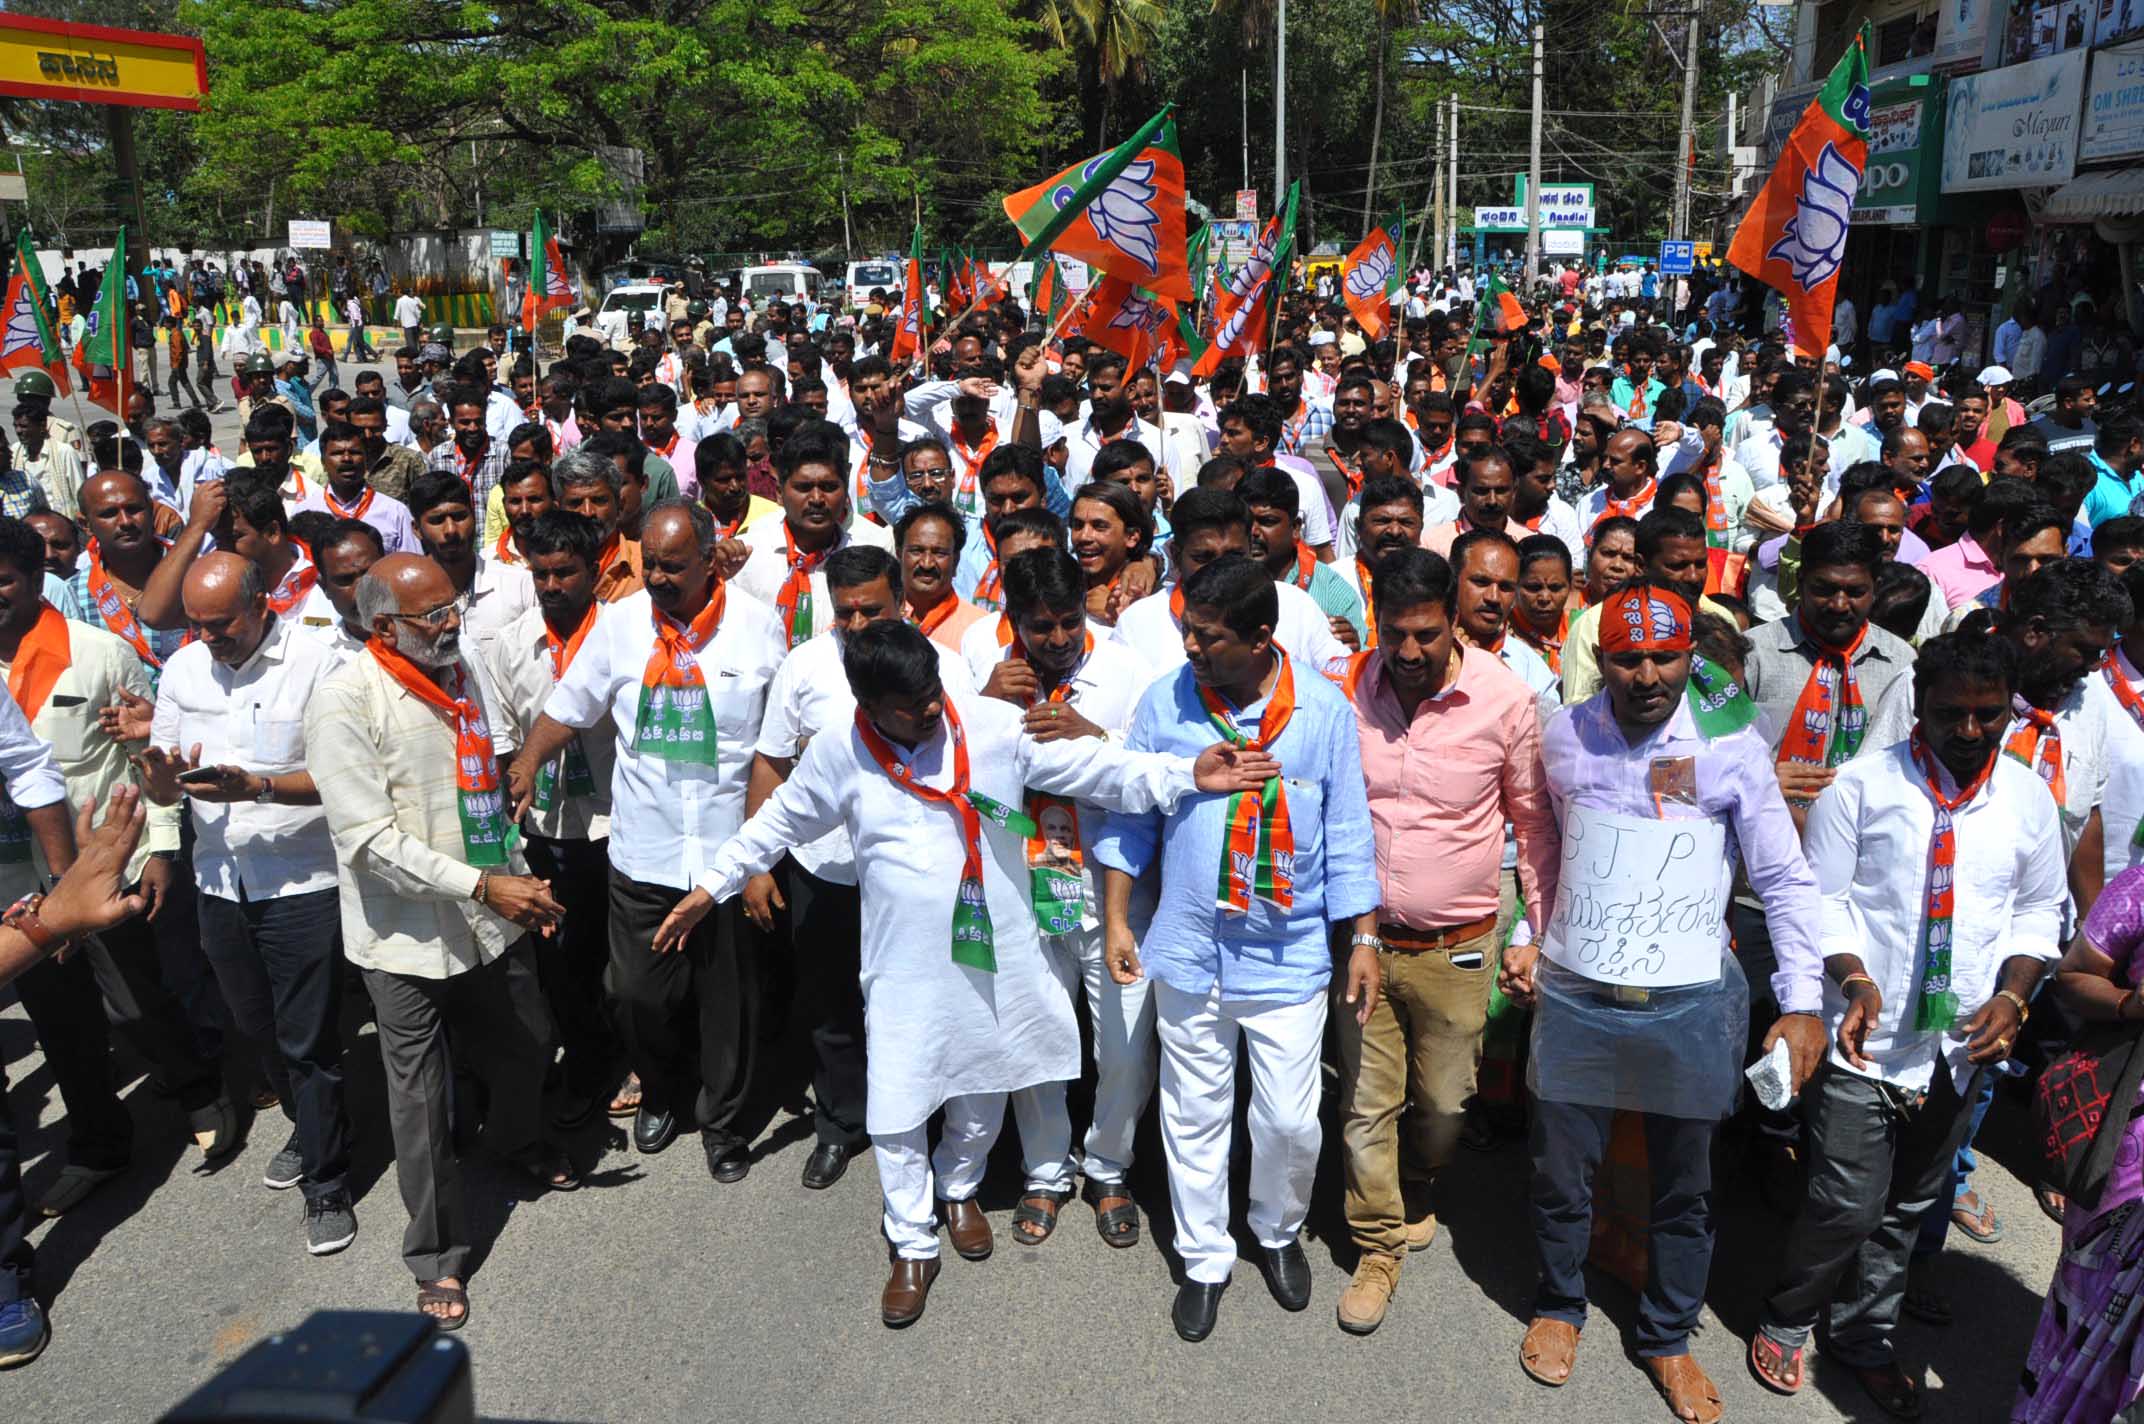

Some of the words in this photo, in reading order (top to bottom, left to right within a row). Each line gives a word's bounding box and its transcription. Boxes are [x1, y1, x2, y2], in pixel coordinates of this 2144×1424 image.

[37, 51, 119, 84] ಹಾಸನ
[2013, 110, 2071, 140] Mayuri
[1549, 211, 1588, 223] Nandini
[1664, 244, 1676, 258] P
